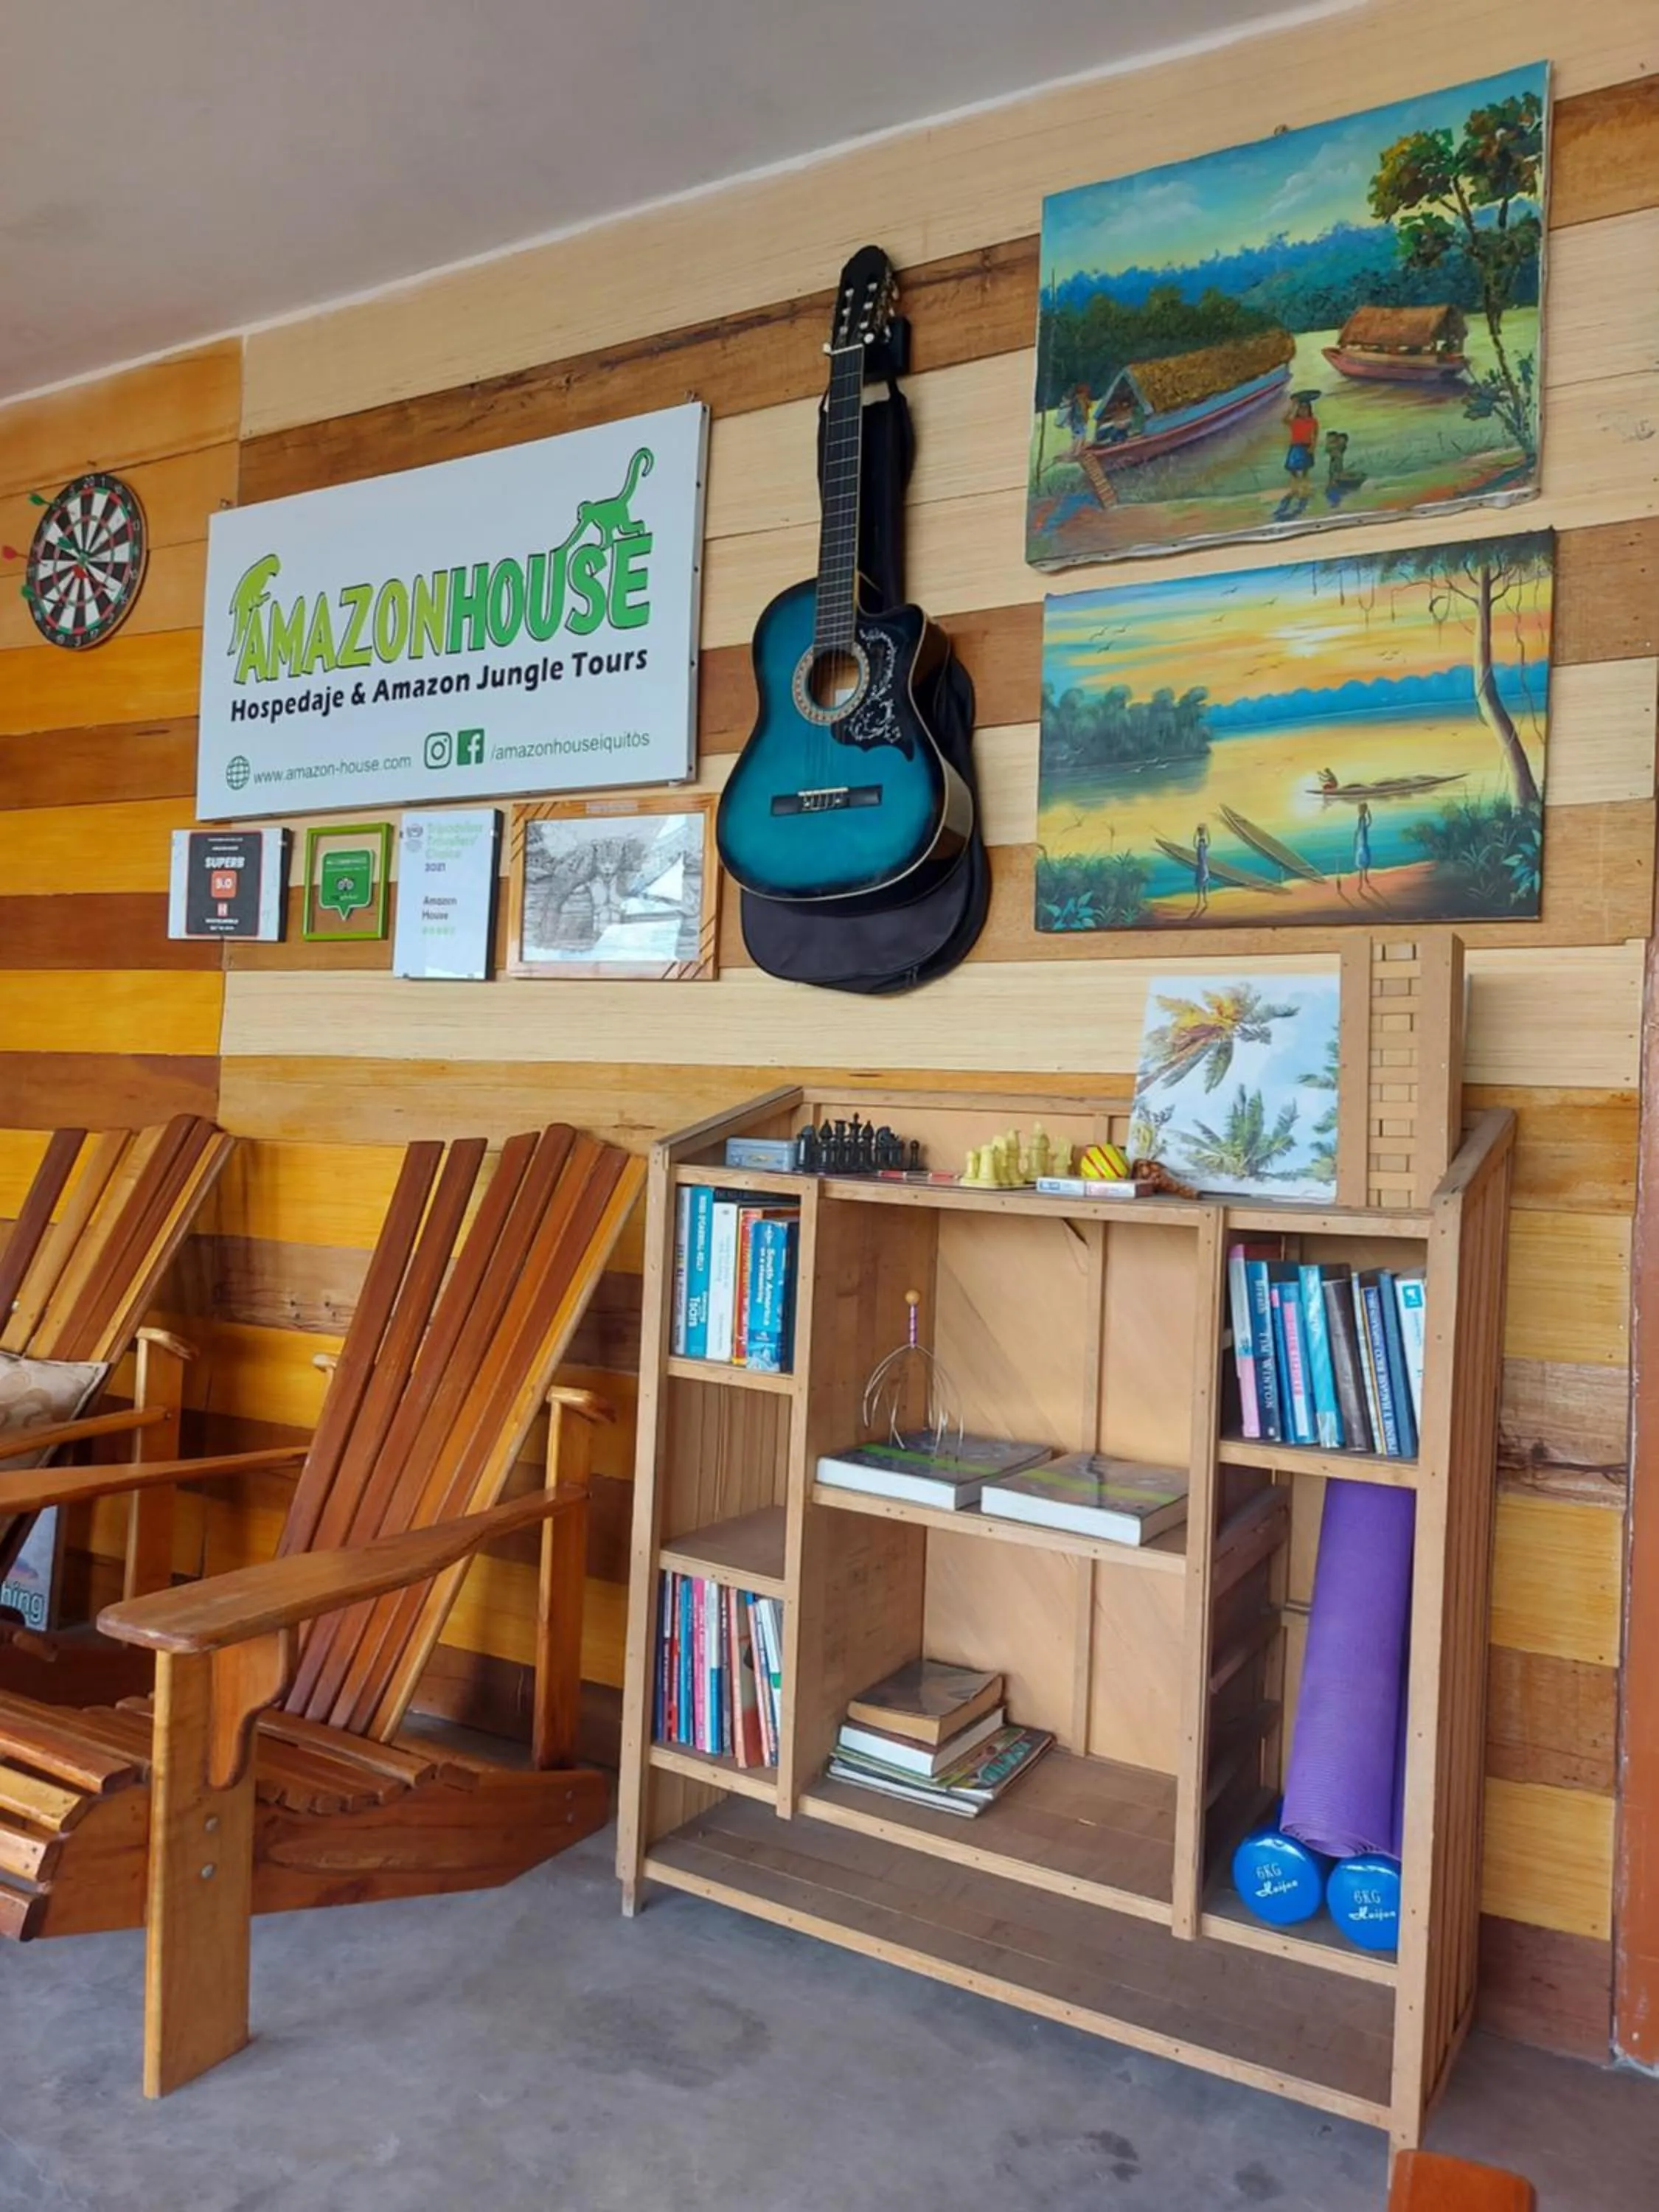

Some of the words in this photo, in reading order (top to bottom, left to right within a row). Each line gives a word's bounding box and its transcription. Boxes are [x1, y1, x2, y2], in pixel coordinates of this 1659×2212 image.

[233, 532, 653, 685] AMAZONHOUSE
[231, 686, 344, 723] Hospedaje
[351, 681, 366, 706] &
[372, 672, 470, 703] Amazon
[476, 656, 564, 692] Jungle
[571, 648, 647, 678] Tours
[253, 754, 412, 785] www.amazon-house.com
[204, 856, 246, 868] SUPERB
[421, 909, 449, 920] House
[422, 895, 458, 905] Amazon
[765, 1248, 776, 1281] South
[762, 1281, 773, 1326] America
[1262, 1357, 1275, 1408] WINTON
[1256, 1863, 1282, 1879] 6KG
[1353, 1889, 1381, 1905] 6KG
